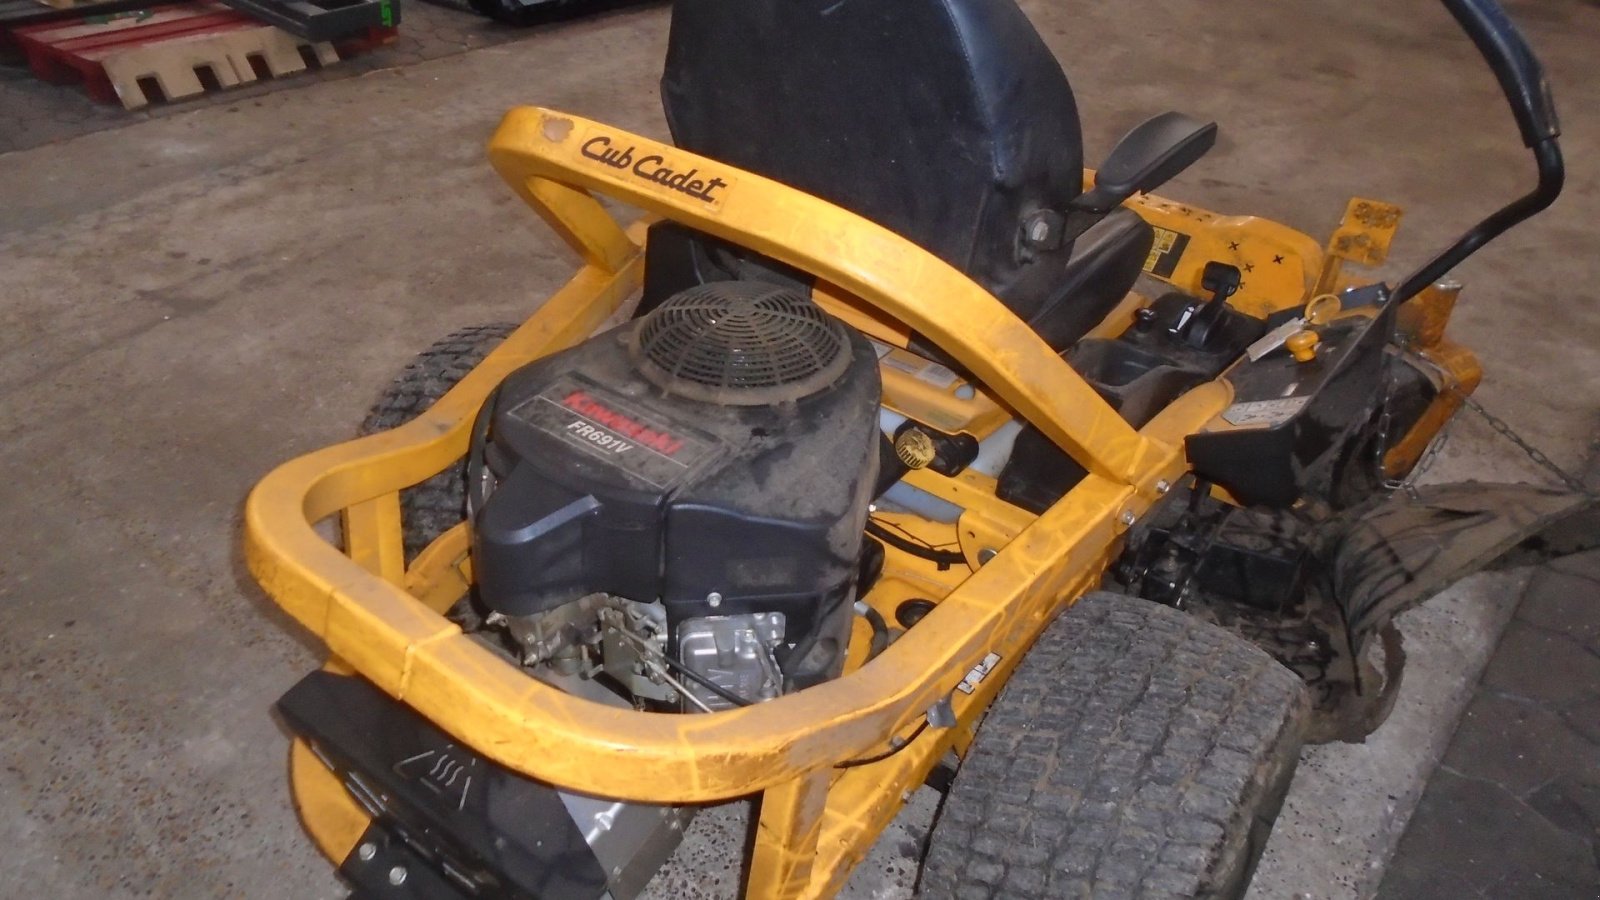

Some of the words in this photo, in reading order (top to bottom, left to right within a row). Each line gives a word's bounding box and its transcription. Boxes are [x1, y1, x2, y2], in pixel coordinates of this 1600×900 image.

[581, 136, 635, 169] Cub
[632, 155, 728, 203] Cadet
[567, 420, 634, 454] FR691V
